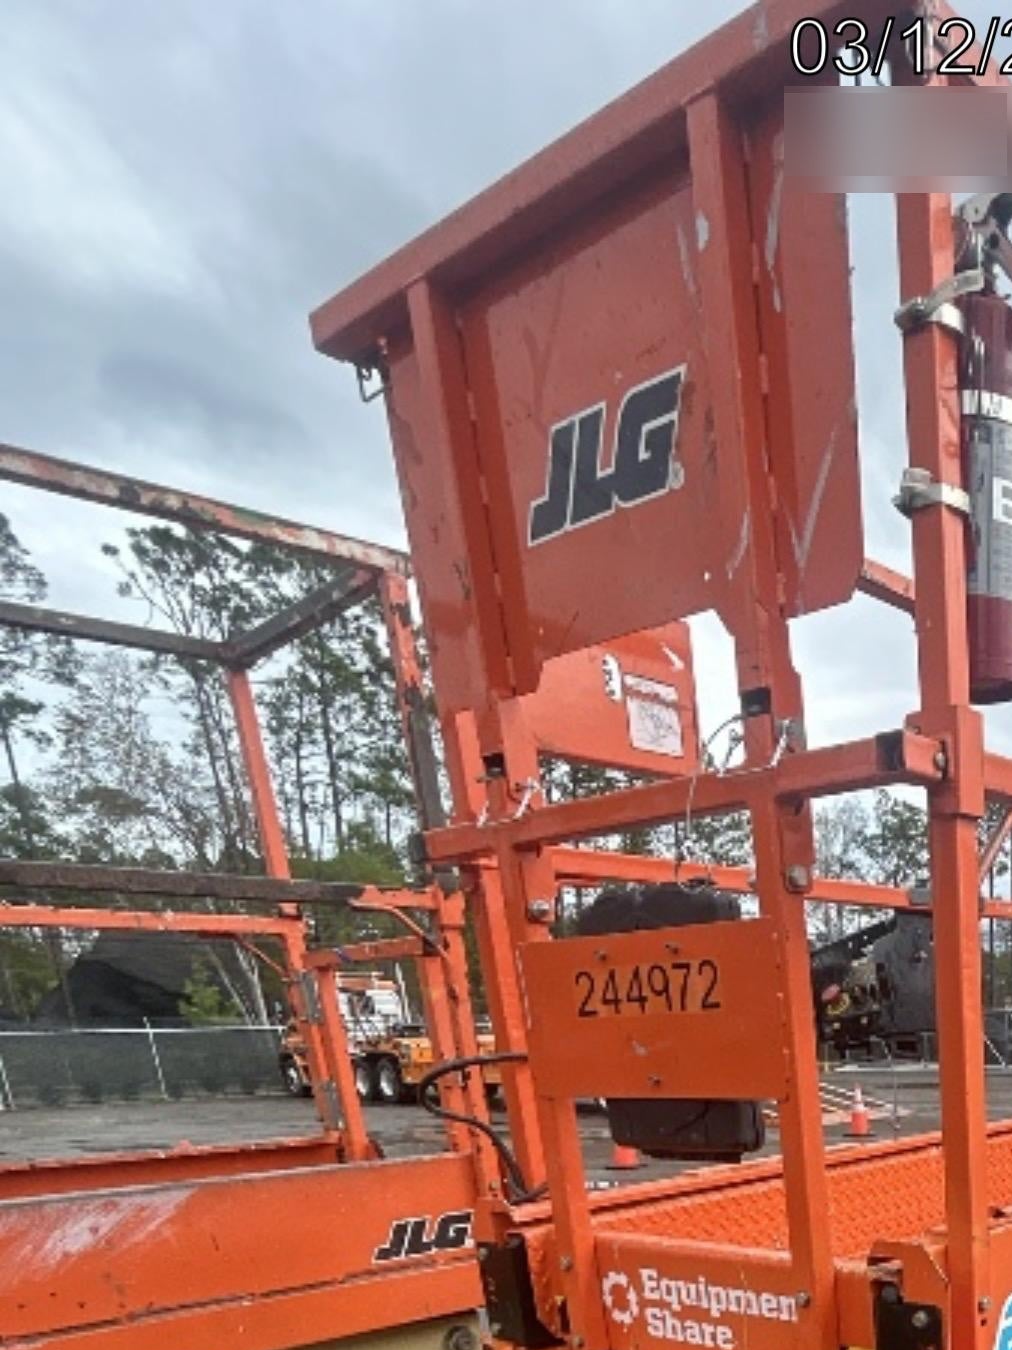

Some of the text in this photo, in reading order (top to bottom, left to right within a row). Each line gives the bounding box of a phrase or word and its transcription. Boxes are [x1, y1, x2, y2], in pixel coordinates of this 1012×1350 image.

[527, 362, 688, 547] JLG
[574, 958, 721, 1018] 244972
[371, 1208, 475, 1264] JLG
[638, 1267, 798, 1324] Equipmen
